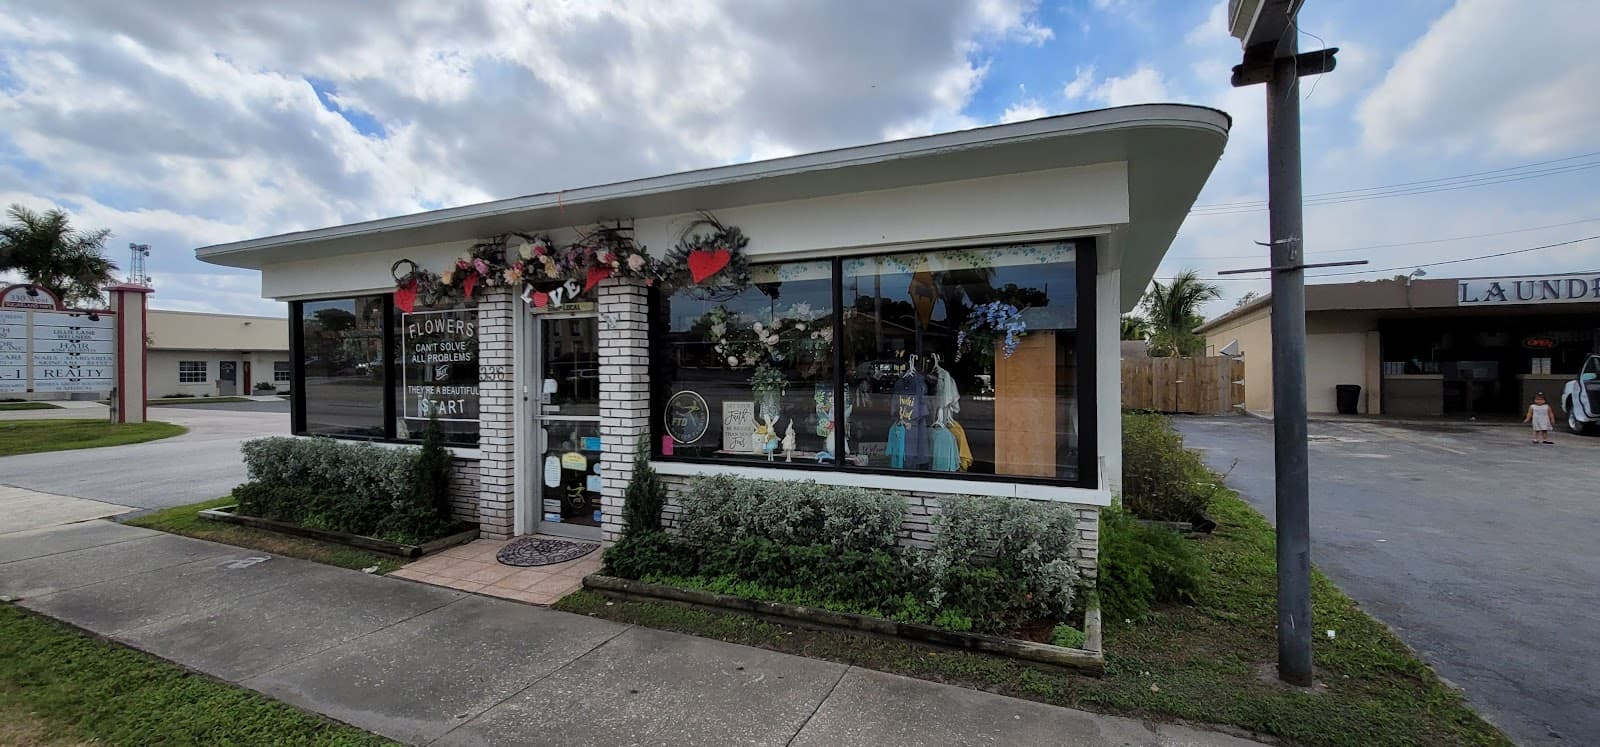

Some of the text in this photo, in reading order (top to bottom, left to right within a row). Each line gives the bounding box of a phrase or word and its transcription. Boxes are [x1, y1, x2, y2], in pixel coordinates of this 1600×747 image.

[408, 319, 474, 339] FLOWERS
[415, 341, 466, 353] CAN'T SOLVE
[411, 352, 471, 363] ALL PROBLEMS
[44, 369, 103, 378] REALTY
[408, 385, 480, 396] THEY'RE A BEAUTIFUL
[671, 417, 688, 427] FTD
